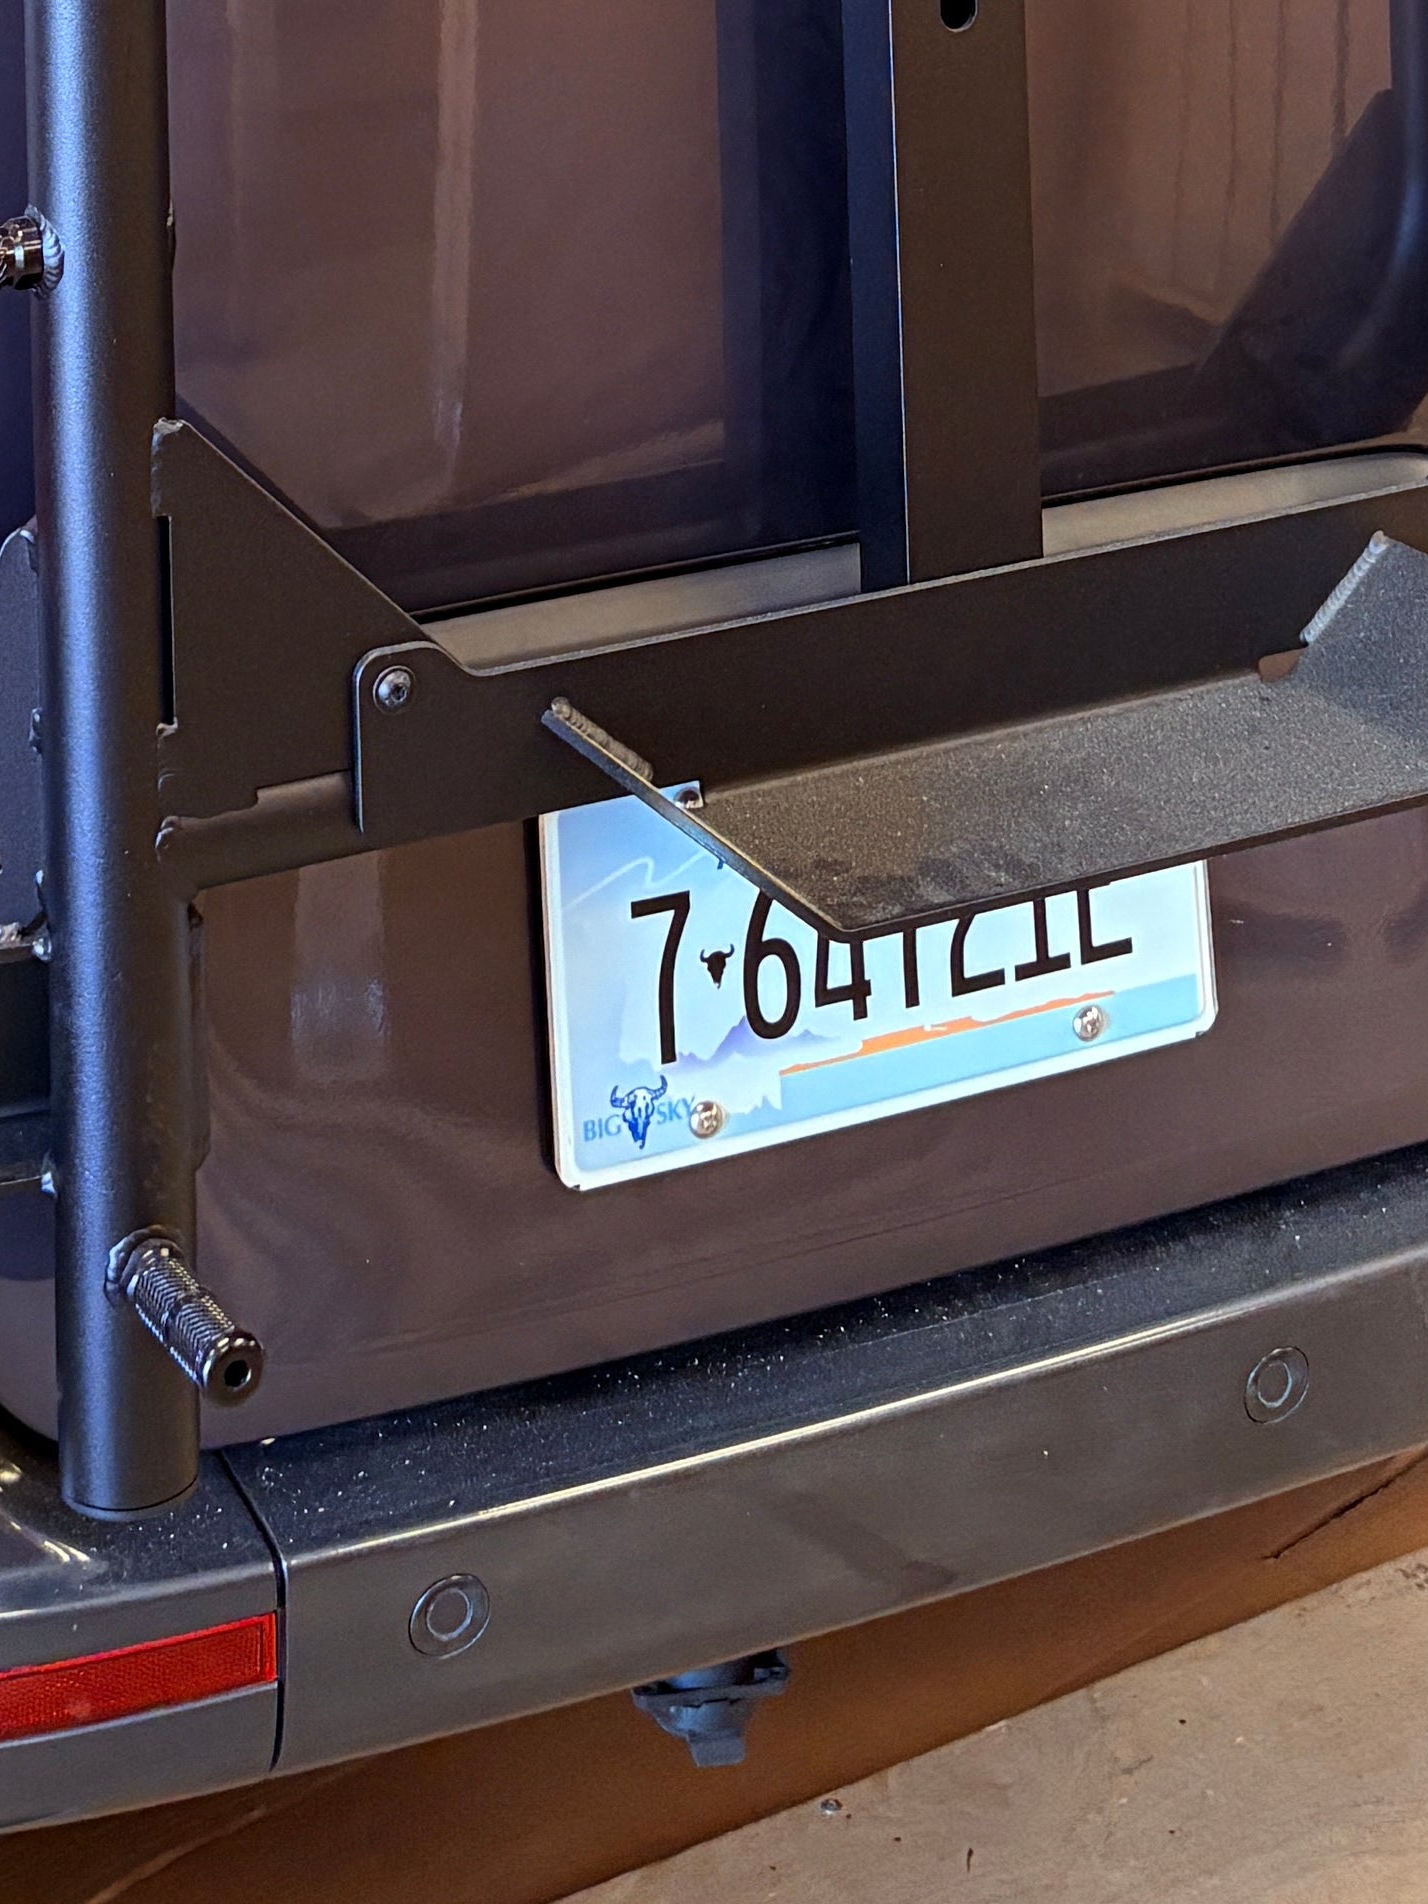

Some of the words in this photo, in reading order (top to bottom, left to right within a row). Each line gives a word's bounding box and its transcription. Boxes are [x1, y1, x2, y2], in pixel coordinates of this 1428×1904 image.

[630, 889, 691, 1065] 7
[583, 1113, 622, 1142] BIG
[655, 1093, 696, 1126] SKY
